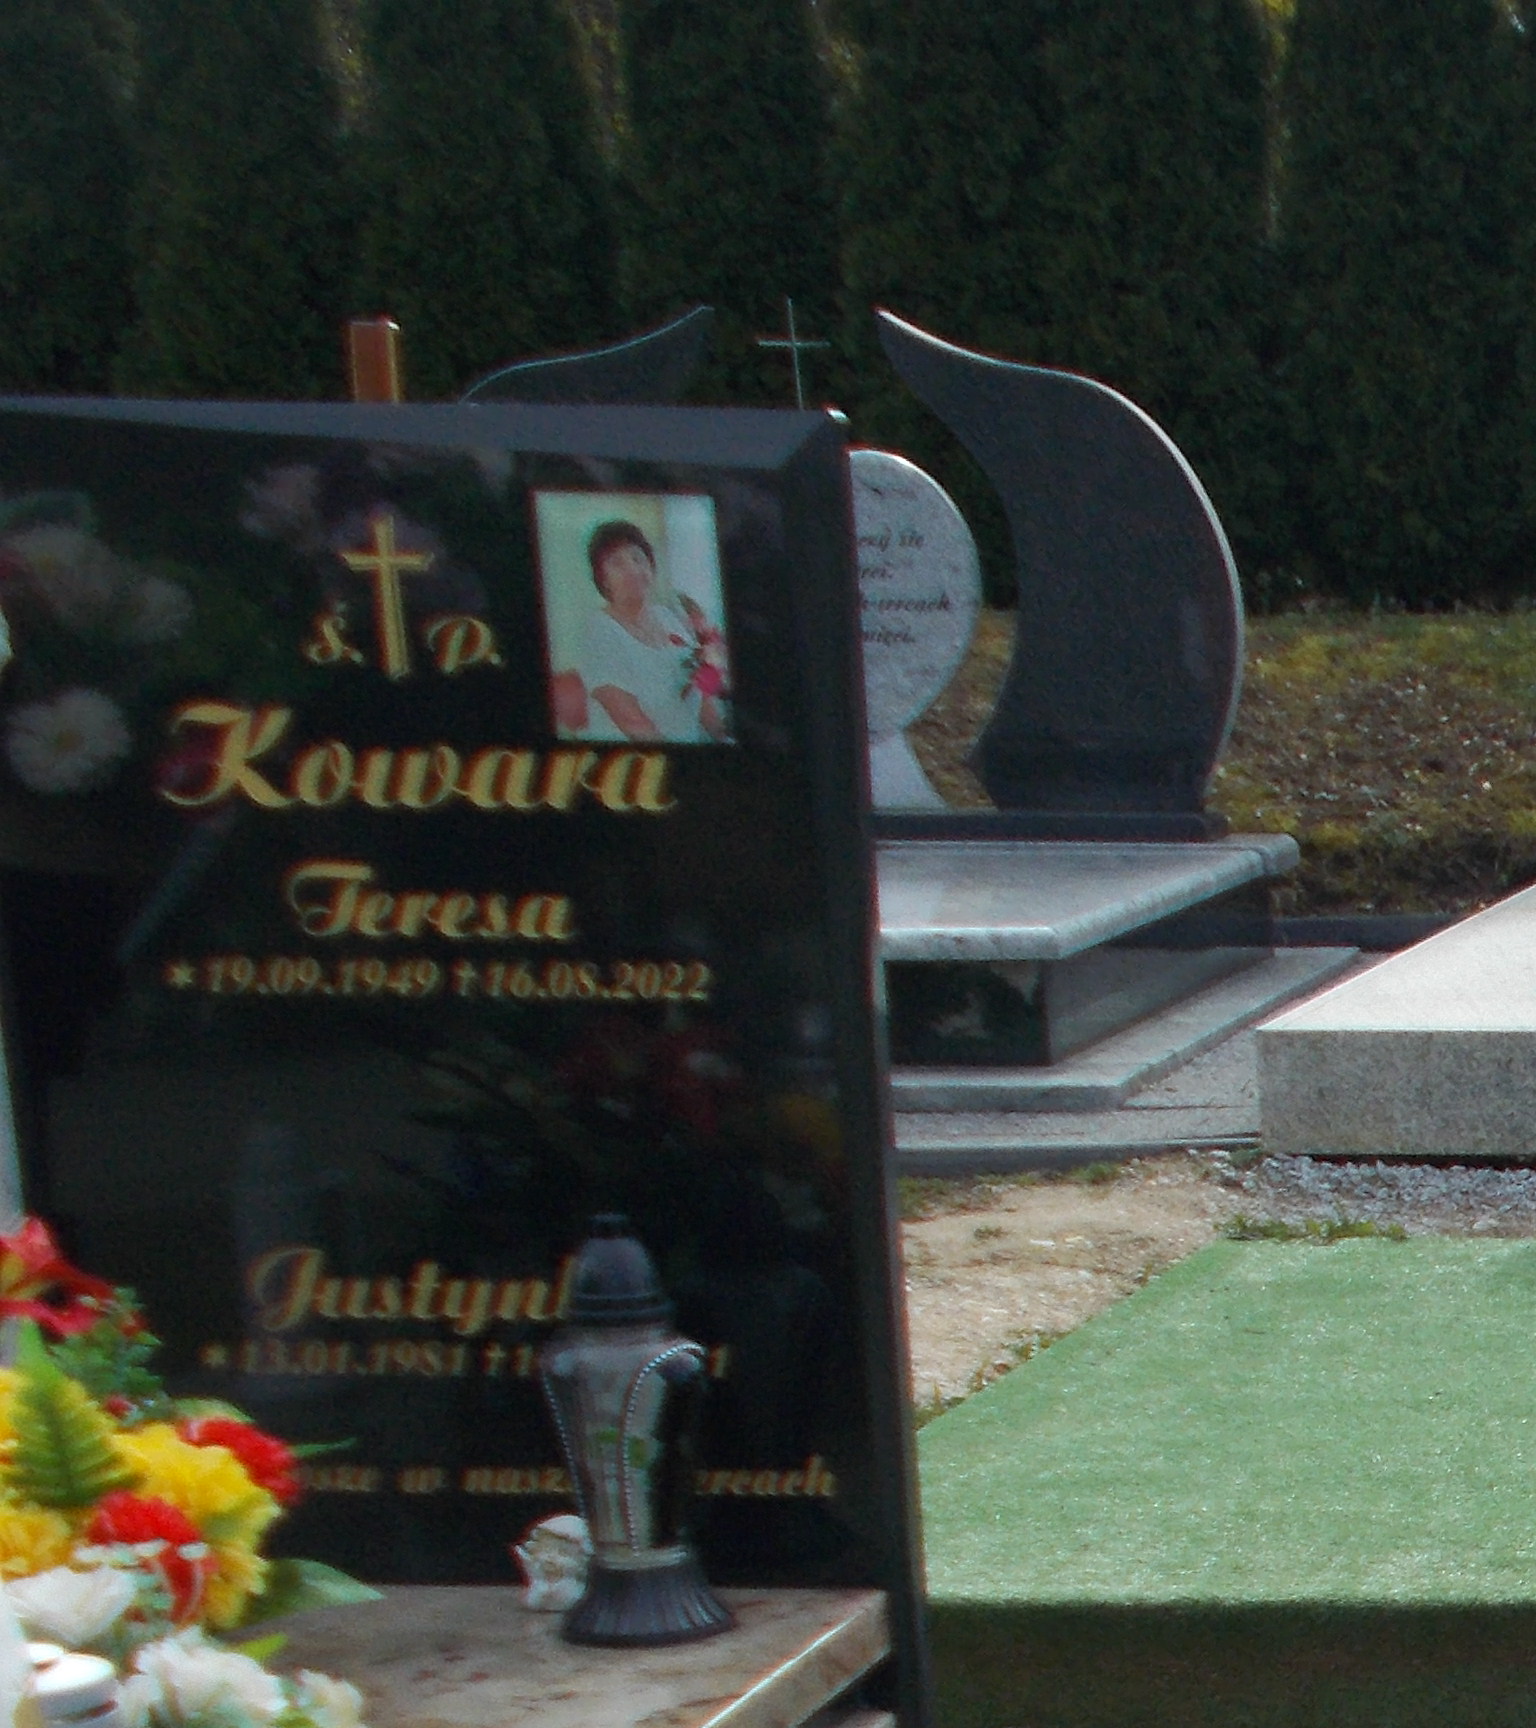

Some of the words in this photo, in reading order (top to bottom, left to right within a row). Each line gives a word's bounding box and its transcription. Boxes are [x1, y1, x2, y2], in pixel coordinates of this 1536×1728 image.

[160, 697, 679, 815] Kowara
[285, 858, 580, 941] Teresa
[246, 1246, 573, 1338] Justyn
